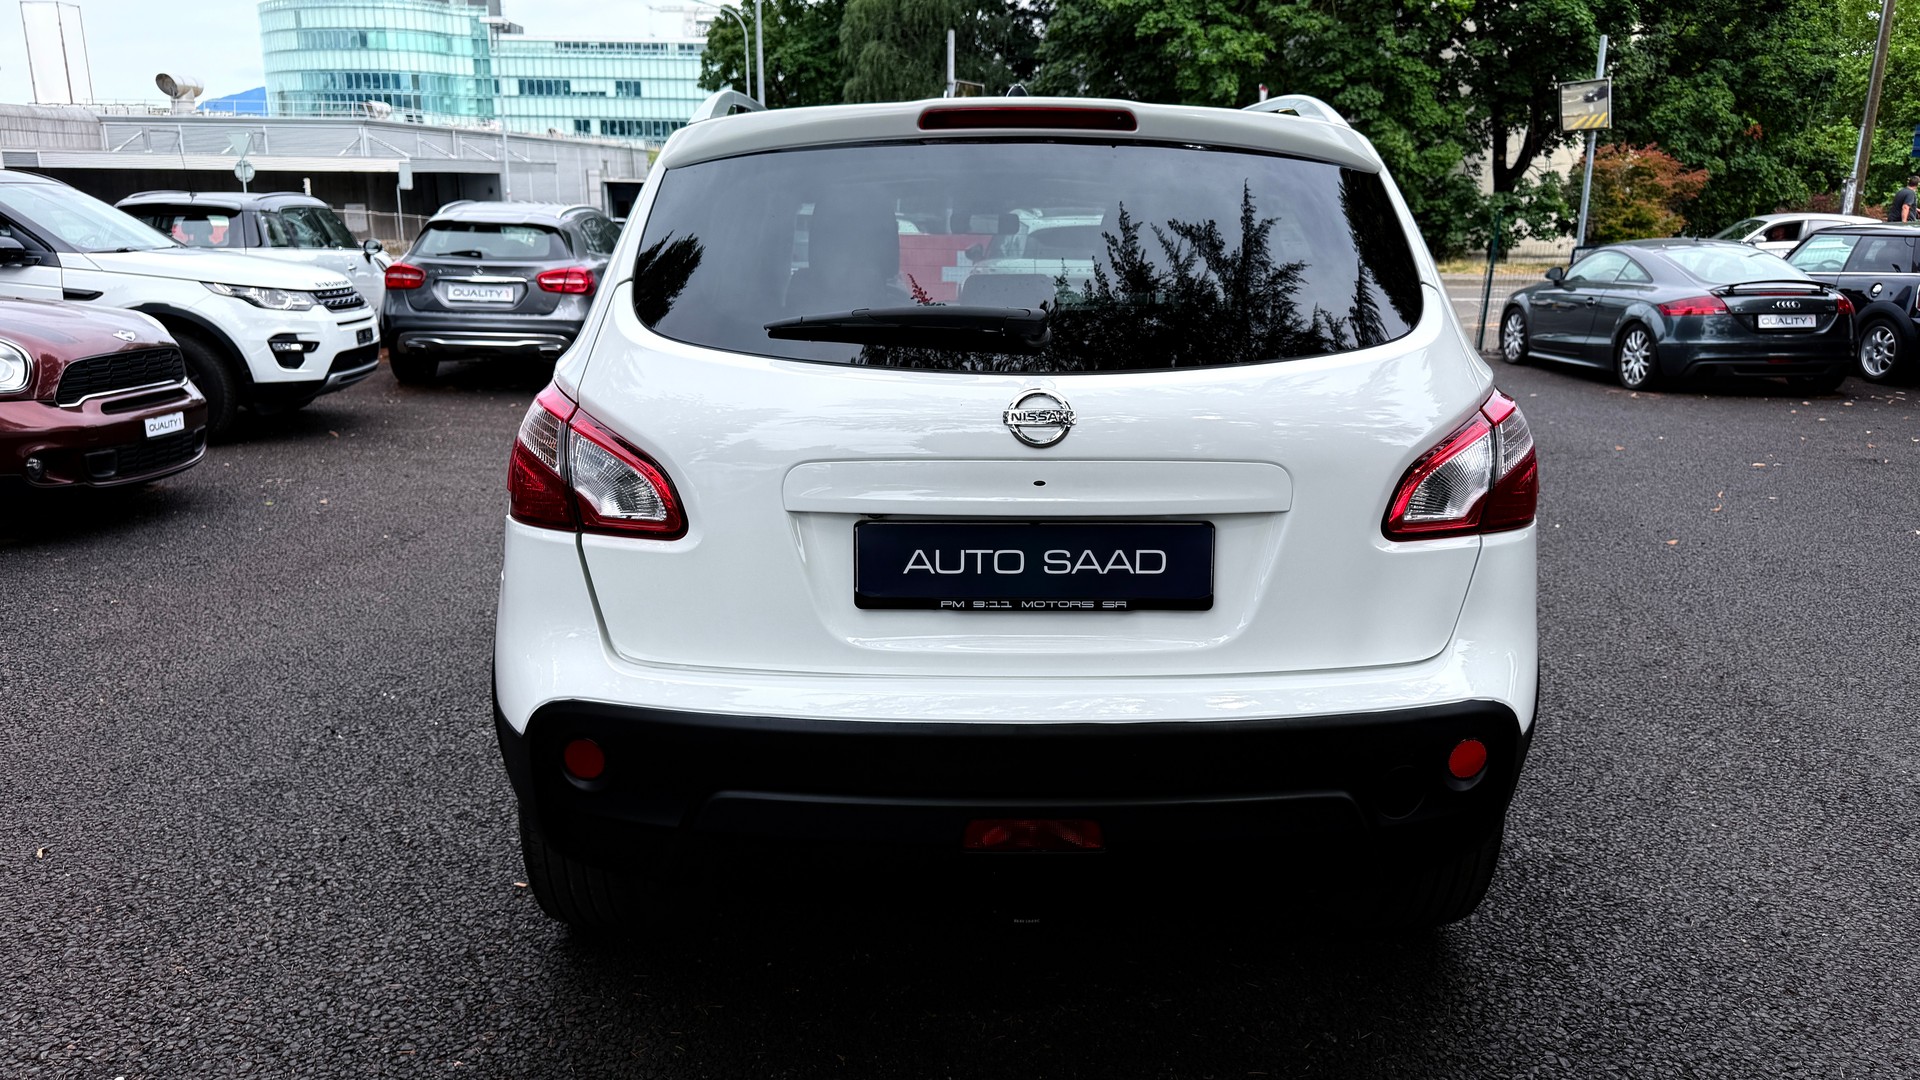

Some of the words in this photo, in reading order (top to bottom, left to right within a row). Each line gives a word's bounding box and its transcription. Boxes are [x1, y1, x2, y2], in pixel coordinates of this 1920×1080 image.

[453, 288, 502, 297] QUALITY
[1761, 317, 1808, 325] QUALITY
[1010, 412, 1069, 421] NISSAN
[149, 419, 177, 432] QUALITY
[902, 549, 1025, 575] AUTO
[1043, 549, 1167, 575] SAAD
[940, 600, 965, 608] PM
[972, 600, 1013, 608] 9:11
[1021, 600, 1095, 608] MOTORS
